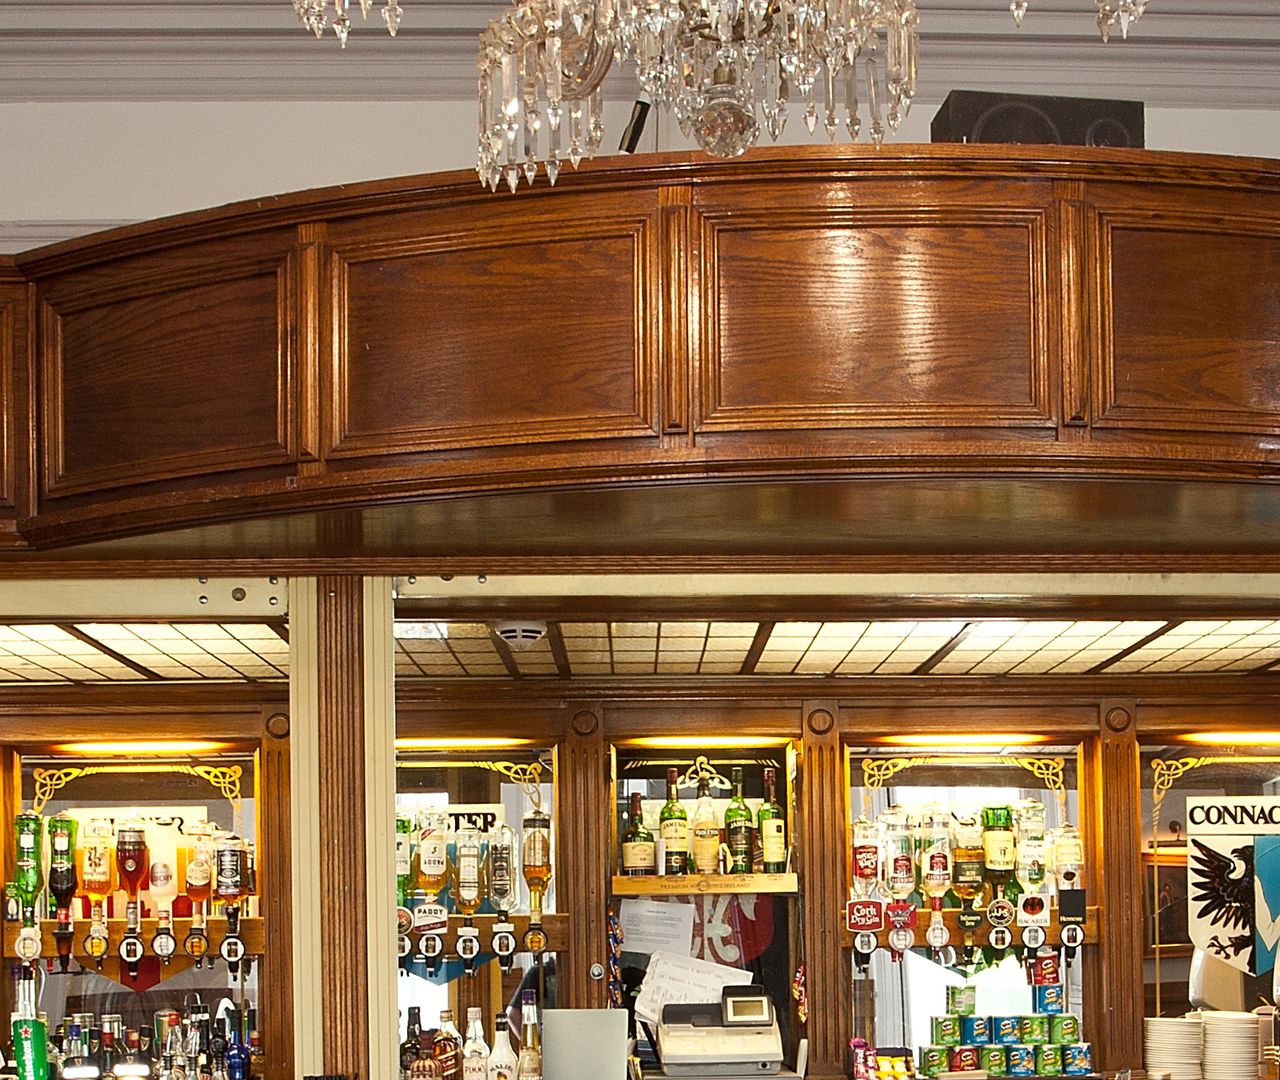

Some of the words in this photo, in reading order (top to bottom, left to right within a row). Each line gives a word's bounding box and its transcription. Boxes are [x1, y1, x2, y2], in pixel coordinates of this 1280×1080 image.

[853, 905, 877, 916] Cork
[850, 915, 865, 925] Dry
[865, 915, 880, 925] Gin
